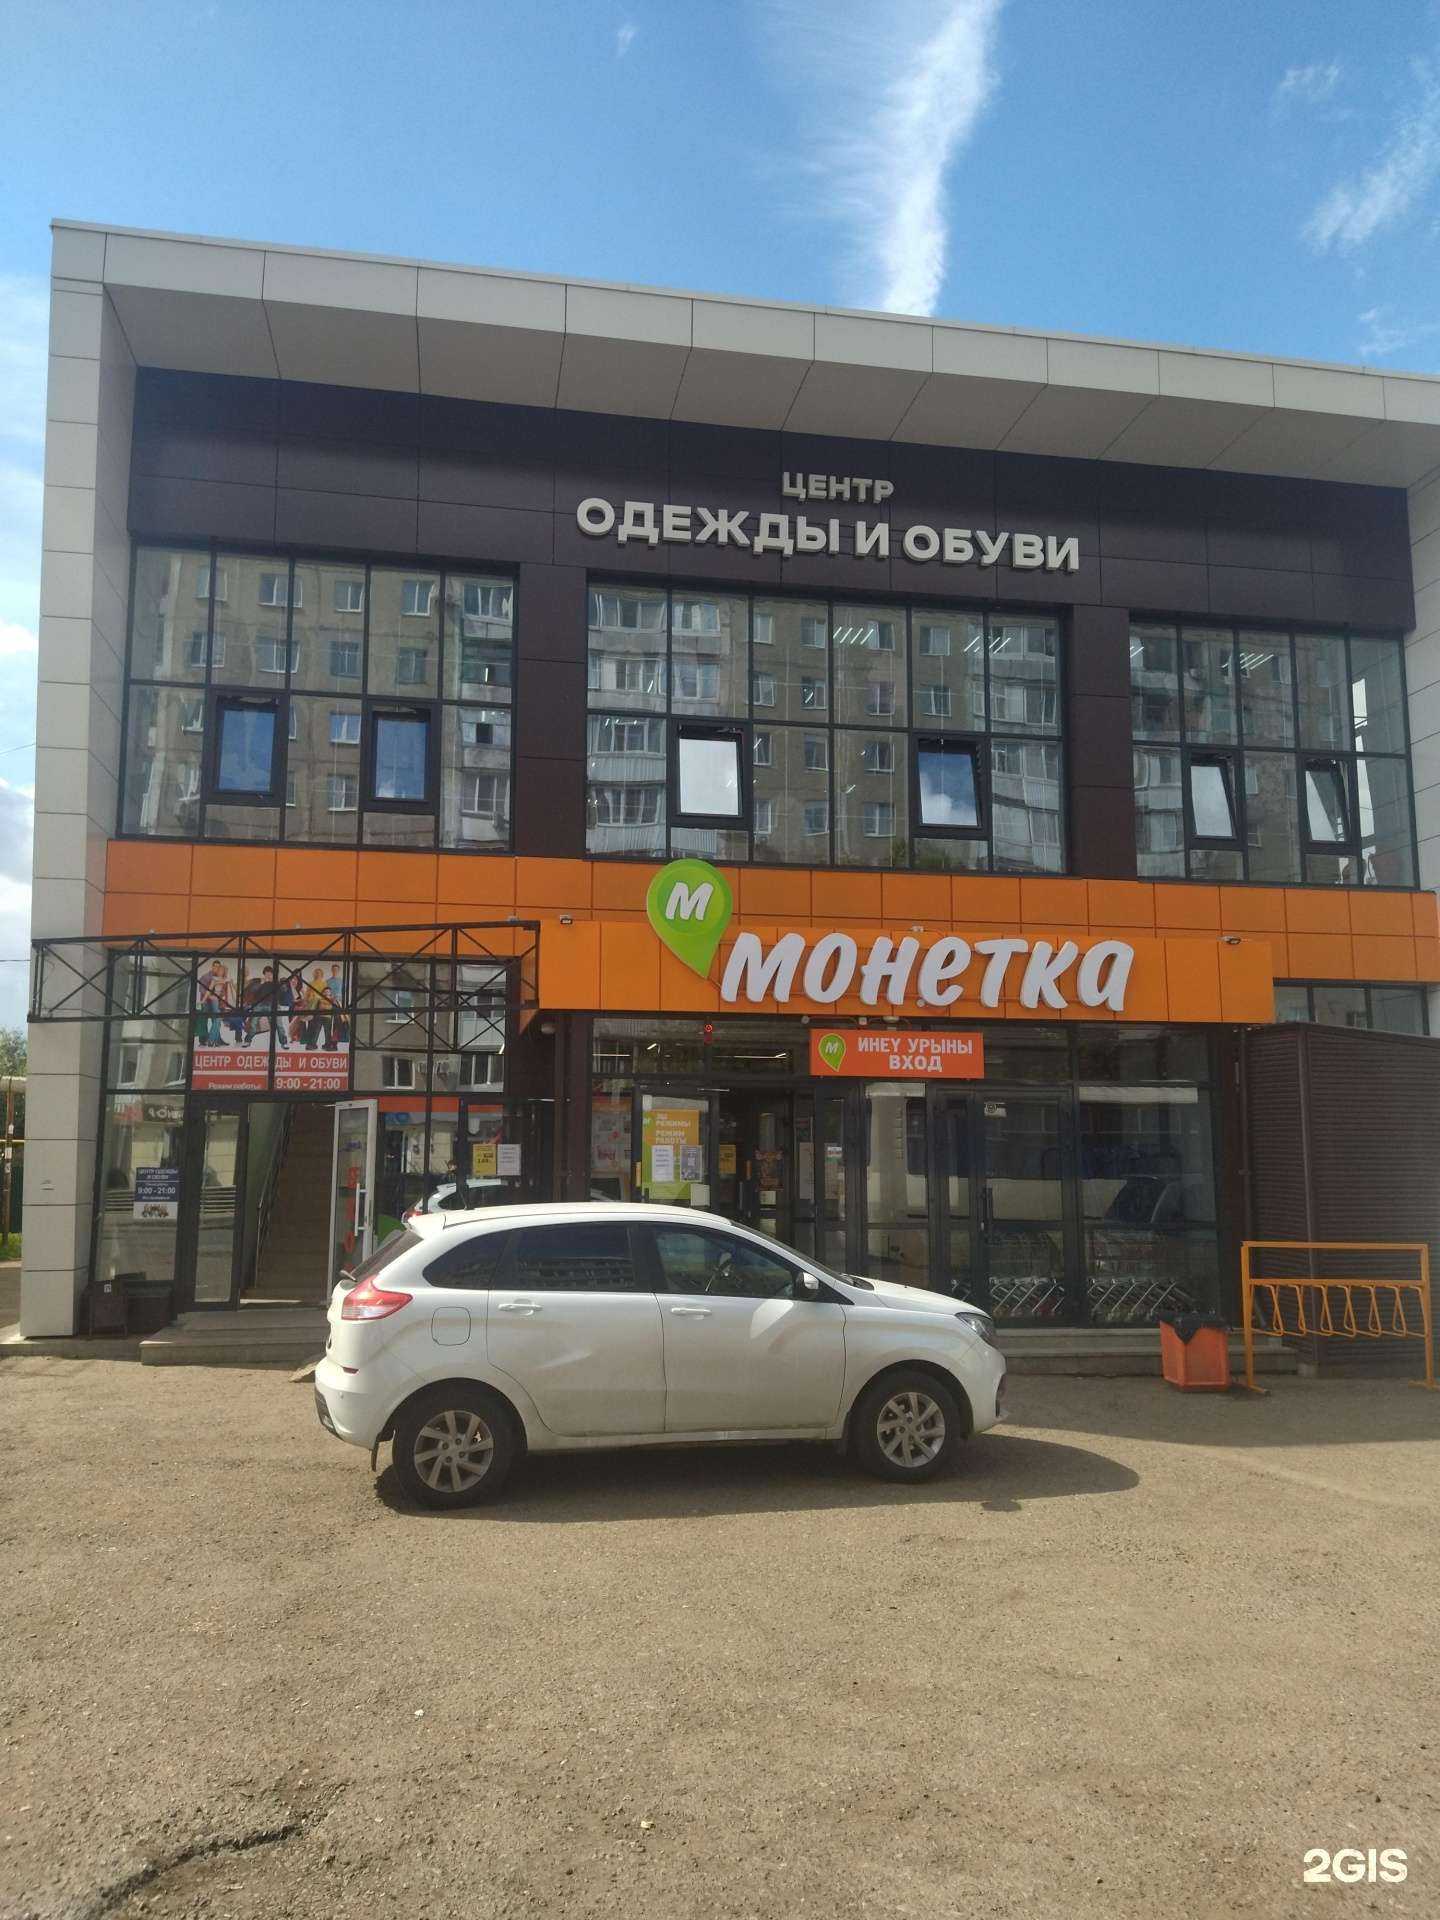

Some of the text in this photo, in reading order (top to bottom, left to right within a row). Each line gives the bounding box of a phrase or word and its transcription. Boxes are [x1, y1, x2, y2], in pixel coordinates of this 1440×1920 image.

[782, 470, 895, 503] ЦЕНТР
[576, 497, 1080, 572] ОДЕЖДЫ И ОБУВИ
[907, 1038, 973, 1055] УРЫНЫ
[194, 1055, 231, 1070] ЦЕНТР
[299, 1057, 307, 1069] И
[310, 1057, 347, 1070] ОБУВИ
[888, 1054, 943, 1073] ВХОД
[276, 1077, 301, 1090] 9:00
[309, 1078, 341, 1090] 21:00
